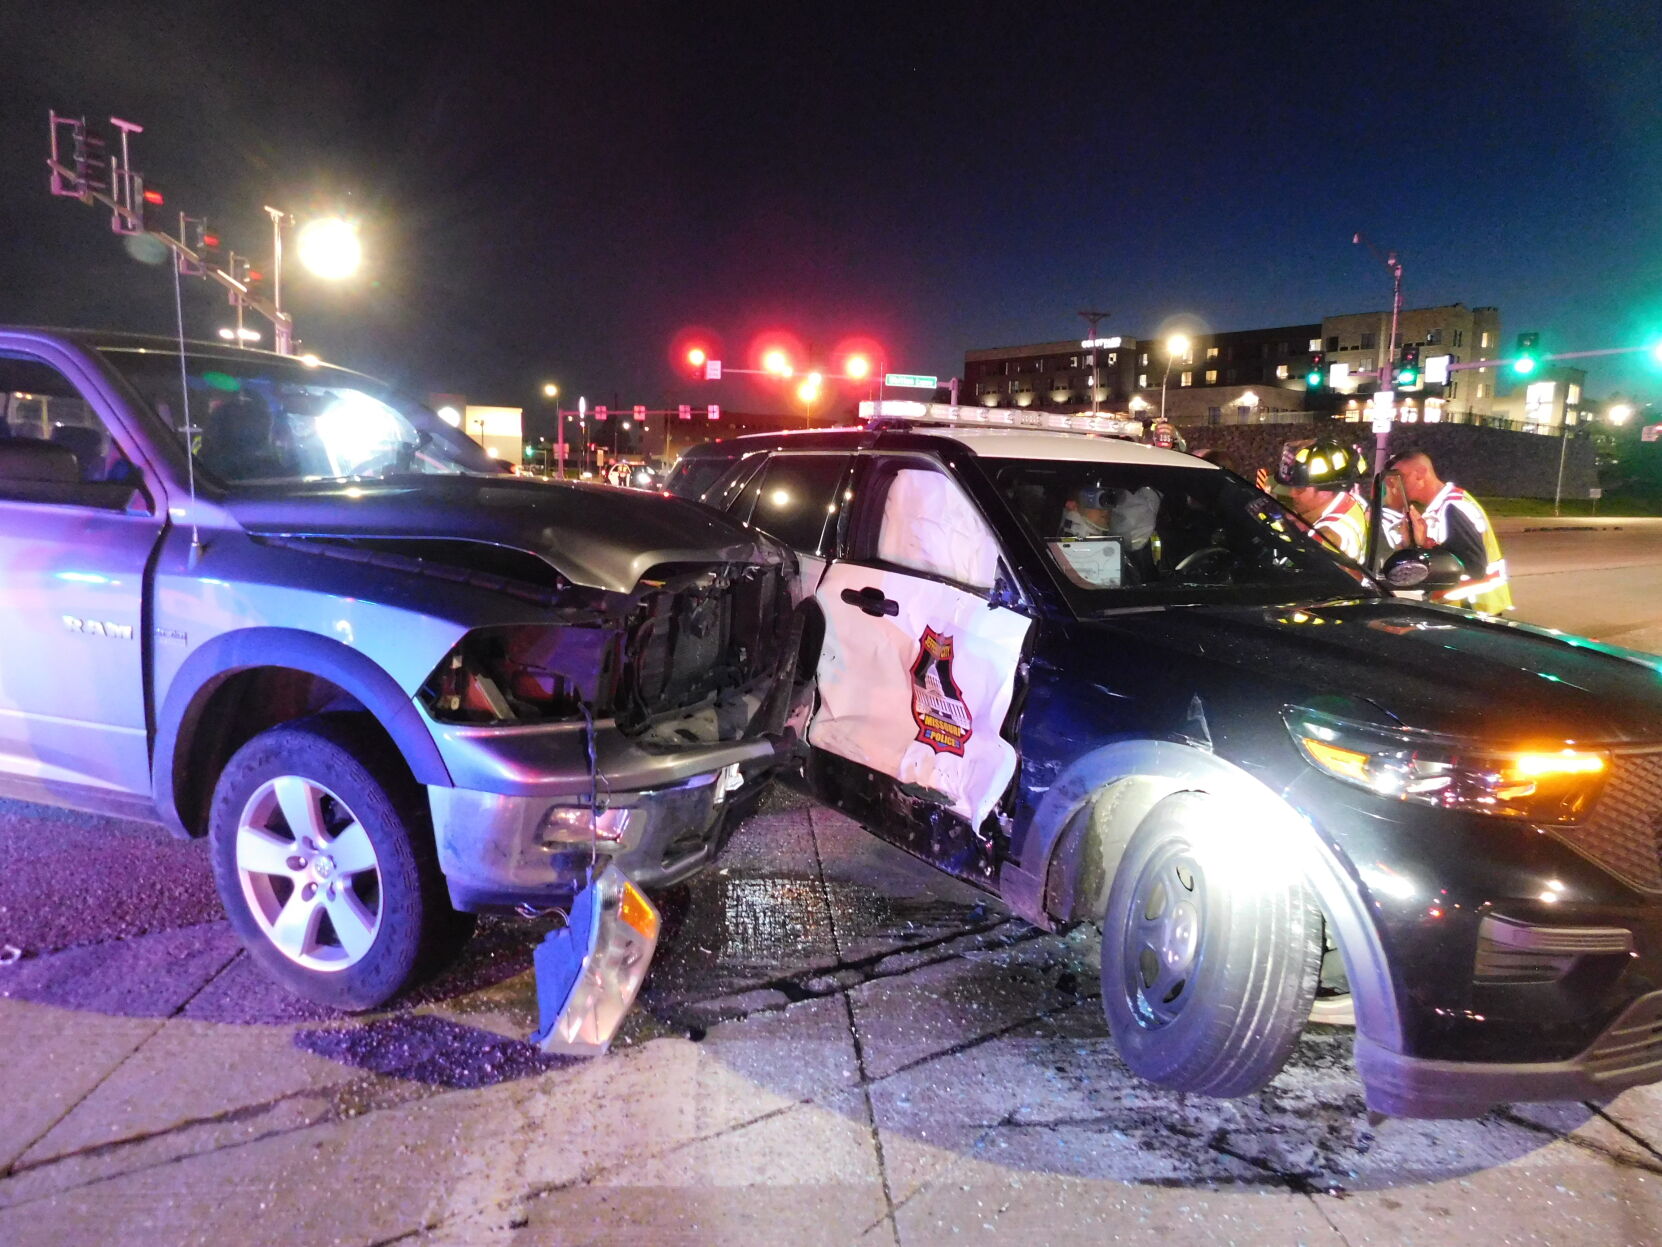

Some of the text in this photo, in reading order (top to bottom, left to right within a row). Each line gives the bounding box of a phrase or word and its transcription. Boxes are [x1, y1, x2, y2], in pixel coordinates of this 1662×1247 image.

[62, 615, 133, 640] RAM
[924, 715, 961, 737] MISSOURI
[930, 731, 955, 747] POLICE
